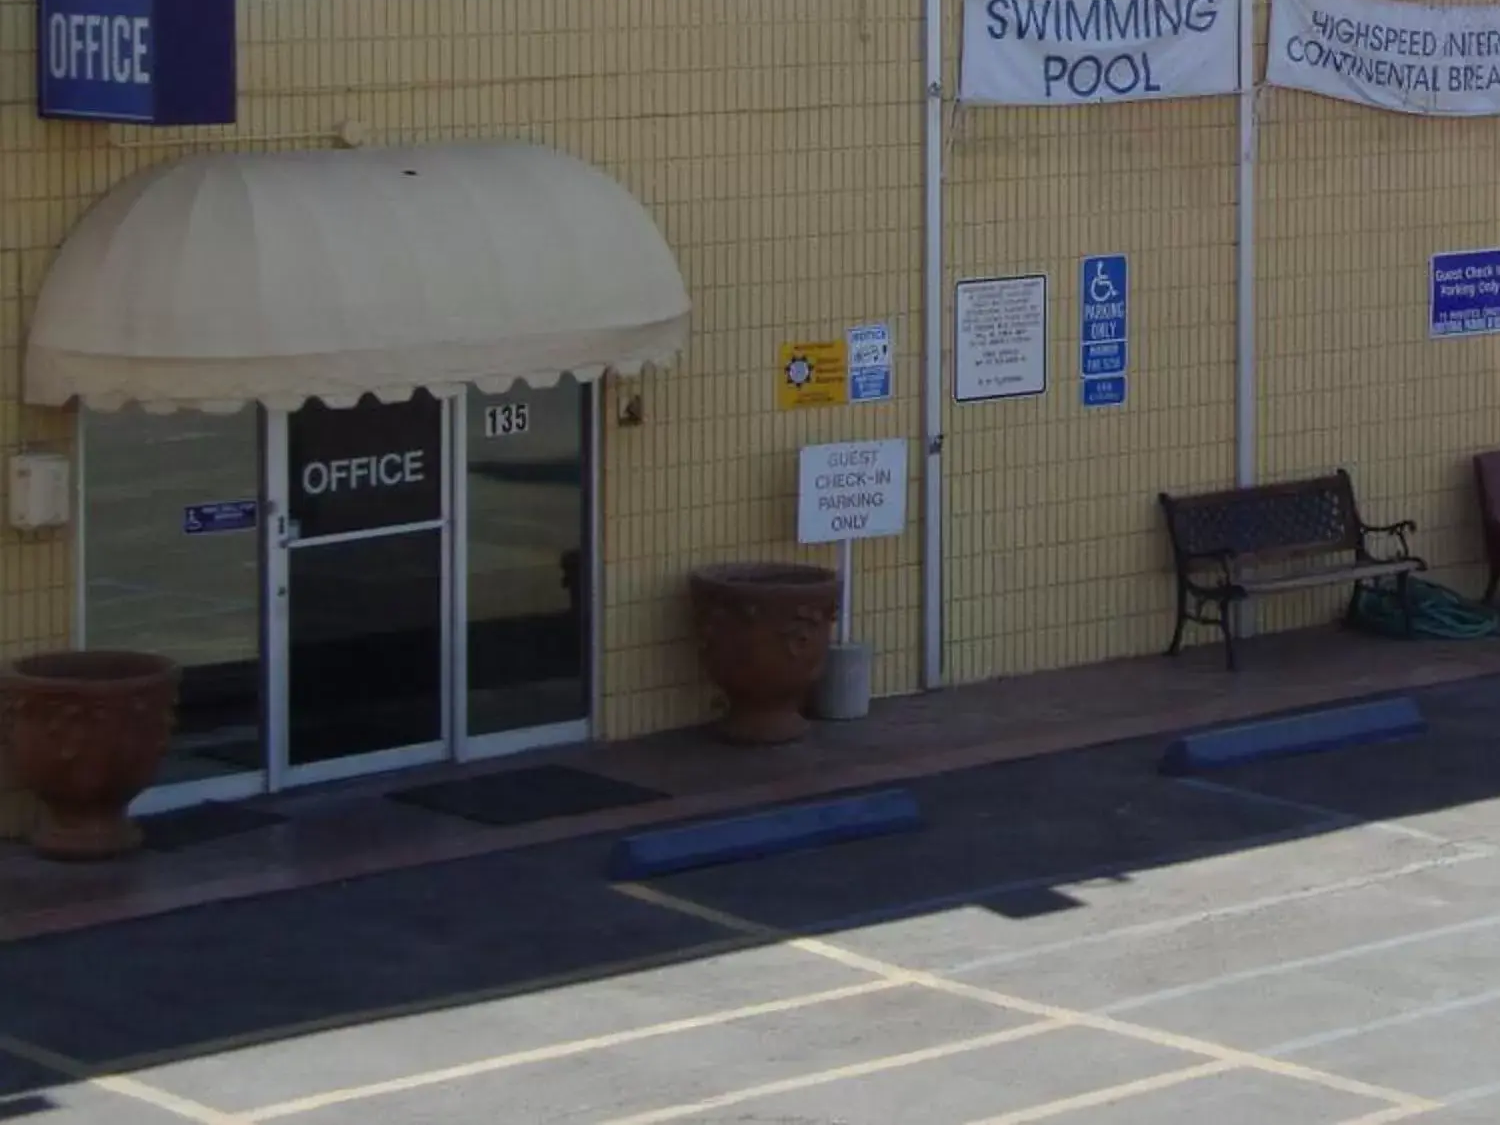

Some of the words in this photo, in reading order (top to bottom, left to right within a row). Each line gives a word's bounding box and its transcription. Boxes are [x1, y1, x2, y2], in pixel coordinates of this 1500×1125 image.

[1311, 9, 1437, 58] HIGHSPEED
[49, 12, 151, 84] OFFICE
[1043, 51, 1161, 97] POOL
[1286, 34, 1441, 93] CONTINENTAL
[1084, 302, 1124, 321] PARKING
[1091, 321, 1118, 340] ONLY
[487, 404, 528, 435] 135
[827, 450, 880, 468] GUEST
[302, 449, 424, 495] OFFICE
[814, 470, 891, 490] CHECK-IN
[818, 492, 885, 511] PARKING
[830, 514, 870, 532] ONLY
